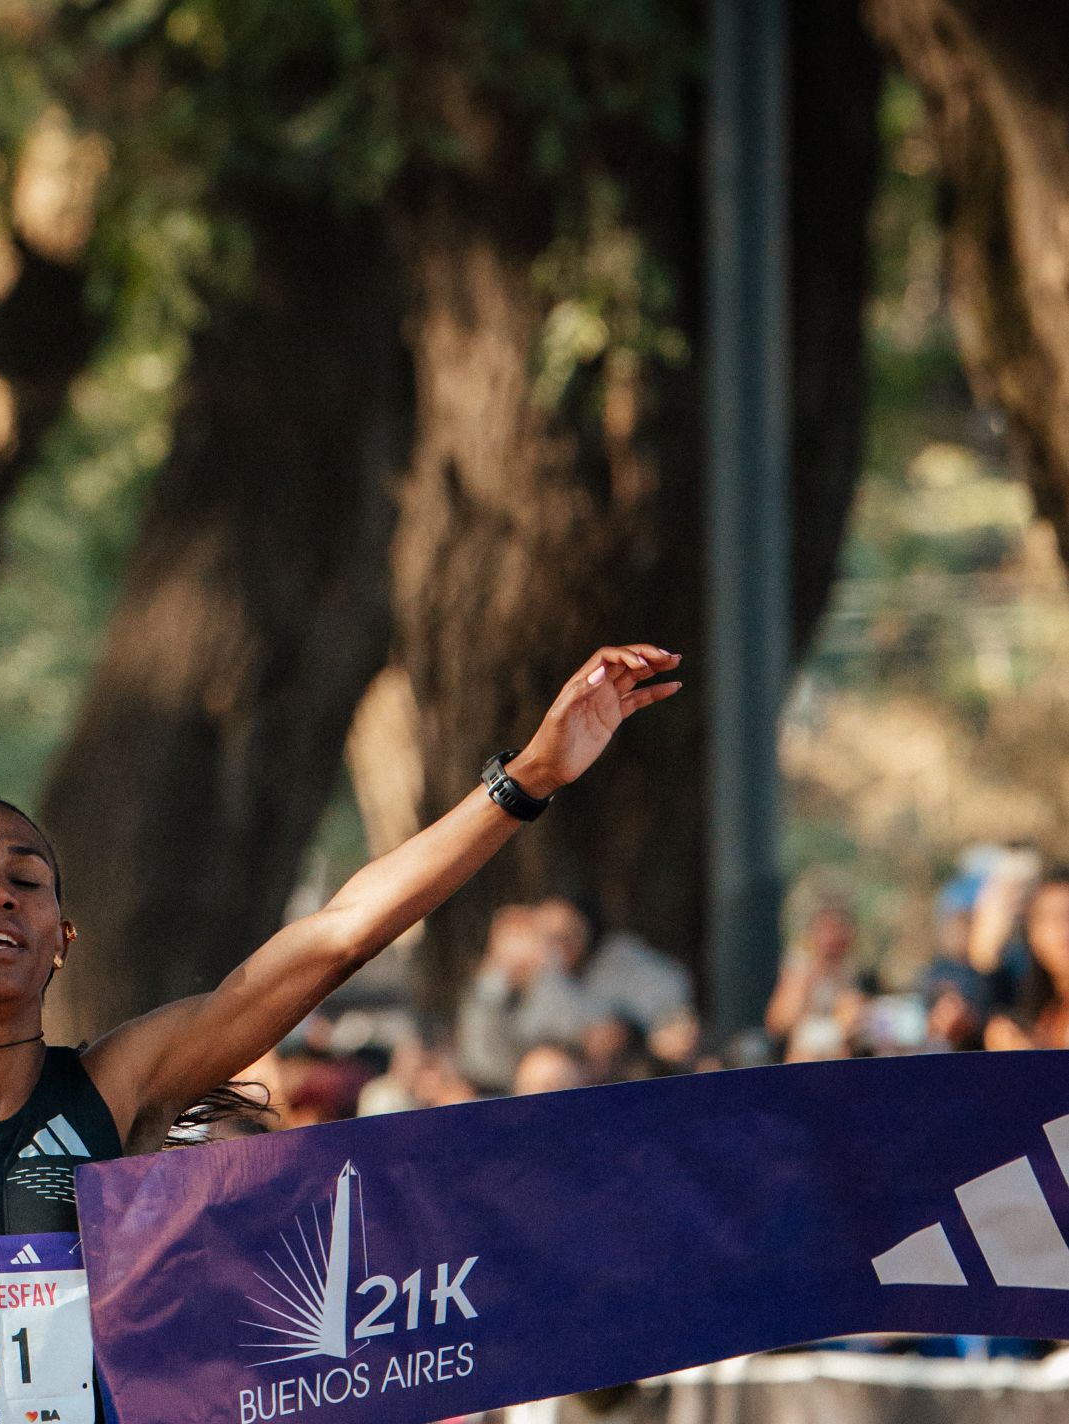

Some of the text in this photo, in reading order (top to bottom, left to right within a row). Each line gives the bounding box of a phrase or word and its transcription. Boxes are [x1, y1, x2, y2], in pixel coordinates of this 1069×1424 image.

[354, 1256, 479, 1340] 21K
[239, 1342, 474, 1424] BUENOS AIRES
